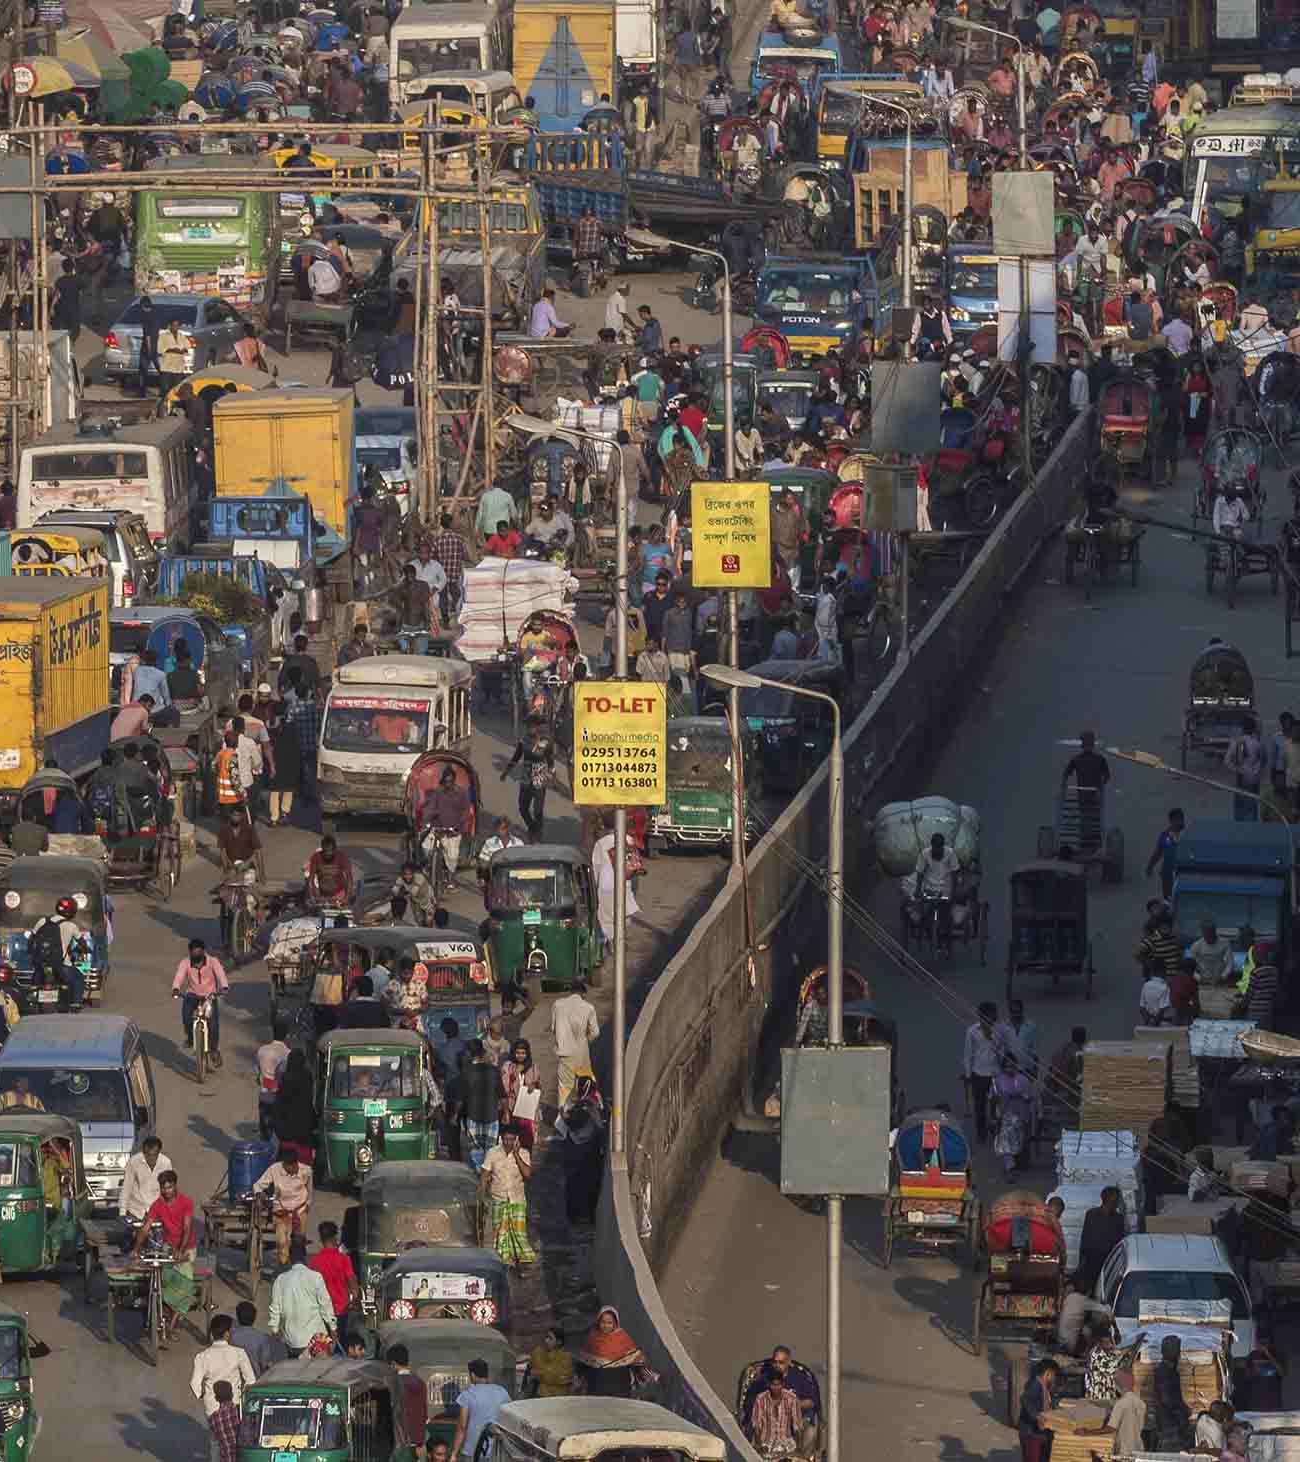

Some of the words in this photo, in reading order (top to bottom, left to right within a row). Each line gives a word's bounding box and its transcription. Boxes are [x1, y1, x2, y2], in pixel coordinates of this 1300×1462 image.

[583, 697, 656, 713] TO-LET
[629, 732, 659, 742] media
[581, 747, 656, 758] 029513764
[448, 943, 473, 953] VIGO
[389, 1114, 403, 1129] CNG
[1, 1206, 16, 1221] CNG
